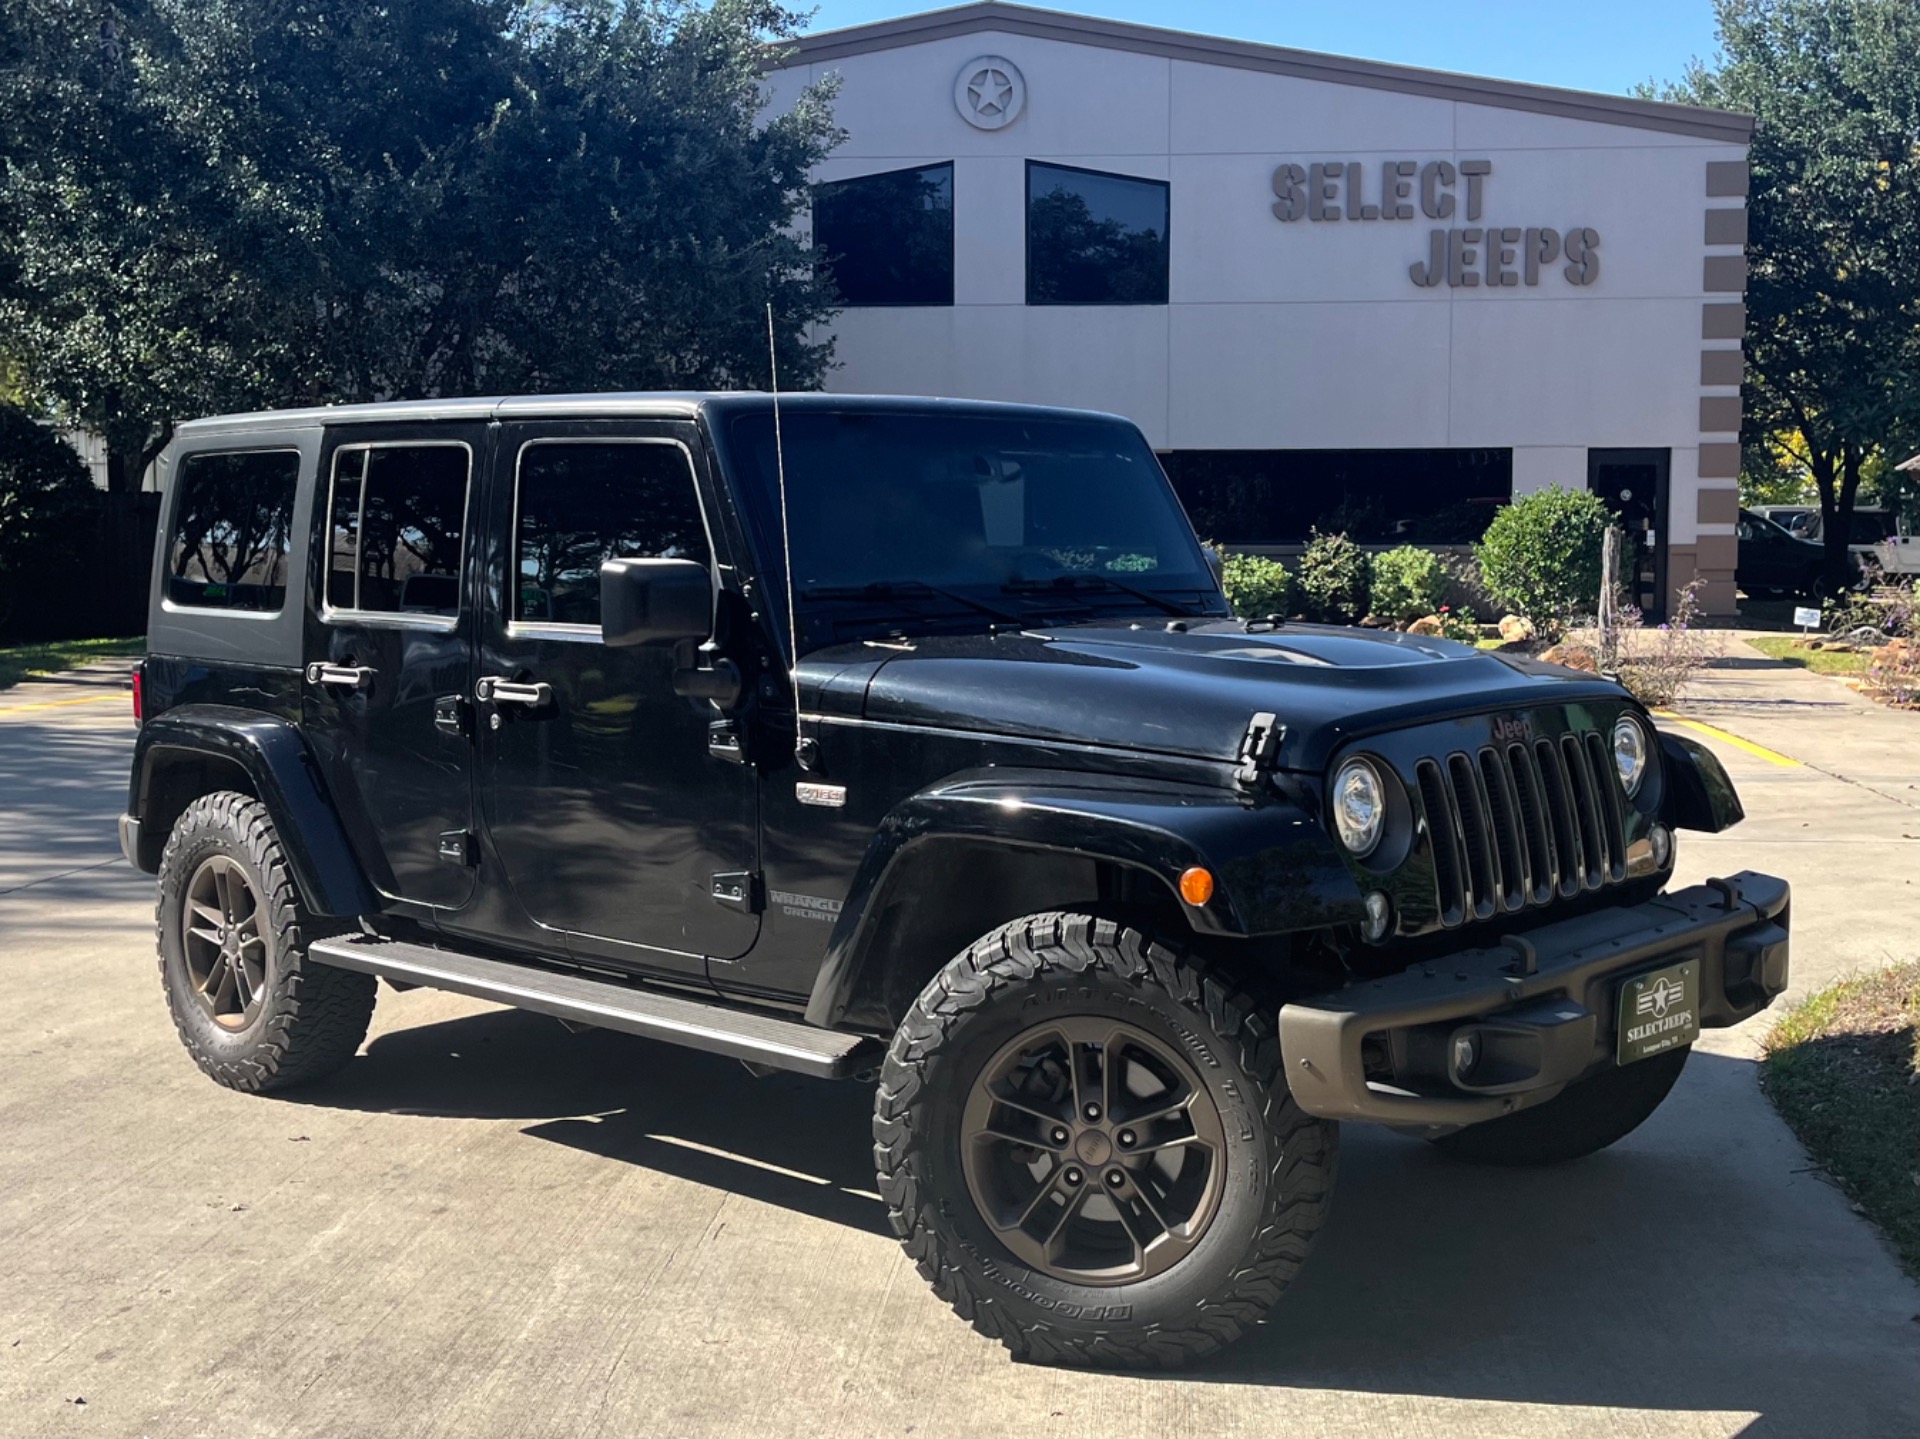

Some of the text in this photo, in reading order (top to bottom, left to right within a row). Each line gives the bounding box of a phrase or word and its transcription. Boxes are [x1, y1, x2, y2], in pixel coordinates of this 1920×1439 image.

[1271, 160, 1492, 222] SELECT
[1409, 227, 1600, 287] JEEPS
[1493, 716, 1532, 740] Jeep
